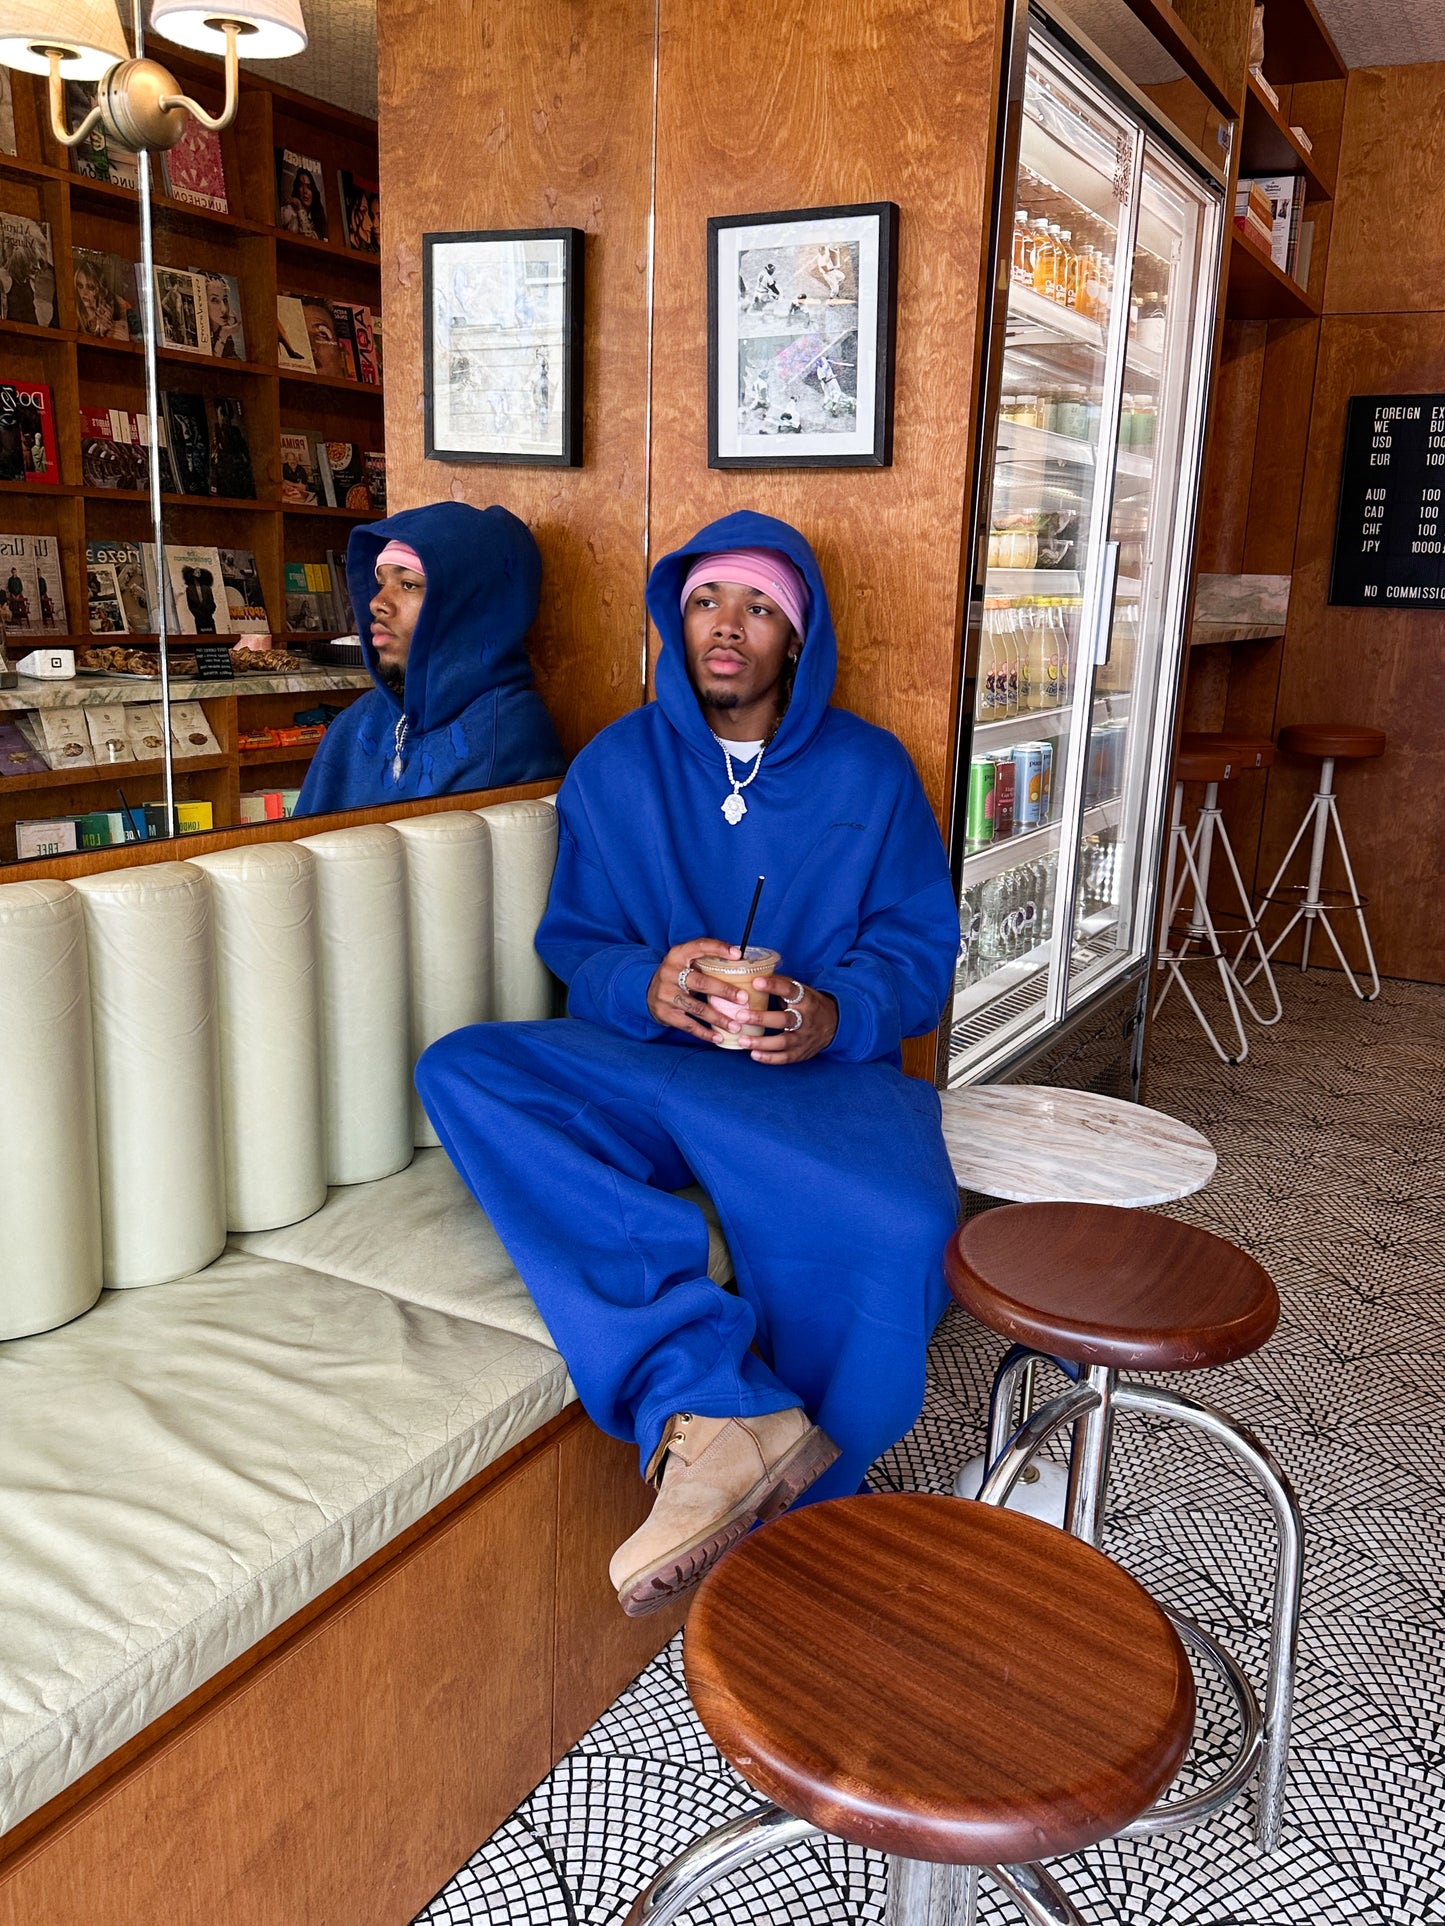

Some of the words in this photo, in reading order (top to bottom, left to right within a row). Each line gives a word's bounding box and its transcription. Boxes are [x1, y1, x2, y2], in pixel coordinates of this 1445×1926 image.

[1375, 407, 1421, 420] FOREIGN
[1431, 406, 1445, 420] EX
[1374, 420, 1390, 433] WE
[1429, 420, 1445, 433] BU
[1372, 435, 1392, 449] USD
[1428, 435, 1445, 449] 100
[1370, 453, 1390, 466] EUR
[1426, 453, 1445, 466] 100
[1365, 488, 1386, 501] AUD
[1422, 488, 1441, 501] 100
[1364, 506, 1384, 519] CAD
[1420, 506, 1439, 519] 100
[1362, 522, 1383, 535] CHF
[1418, 523, 1437, 536] 100
[1361, 540, 1381, 553] JPY
[1363, 585, 1378, 597] NO
[1386, 585, 1445, 599] COMMISSIO
